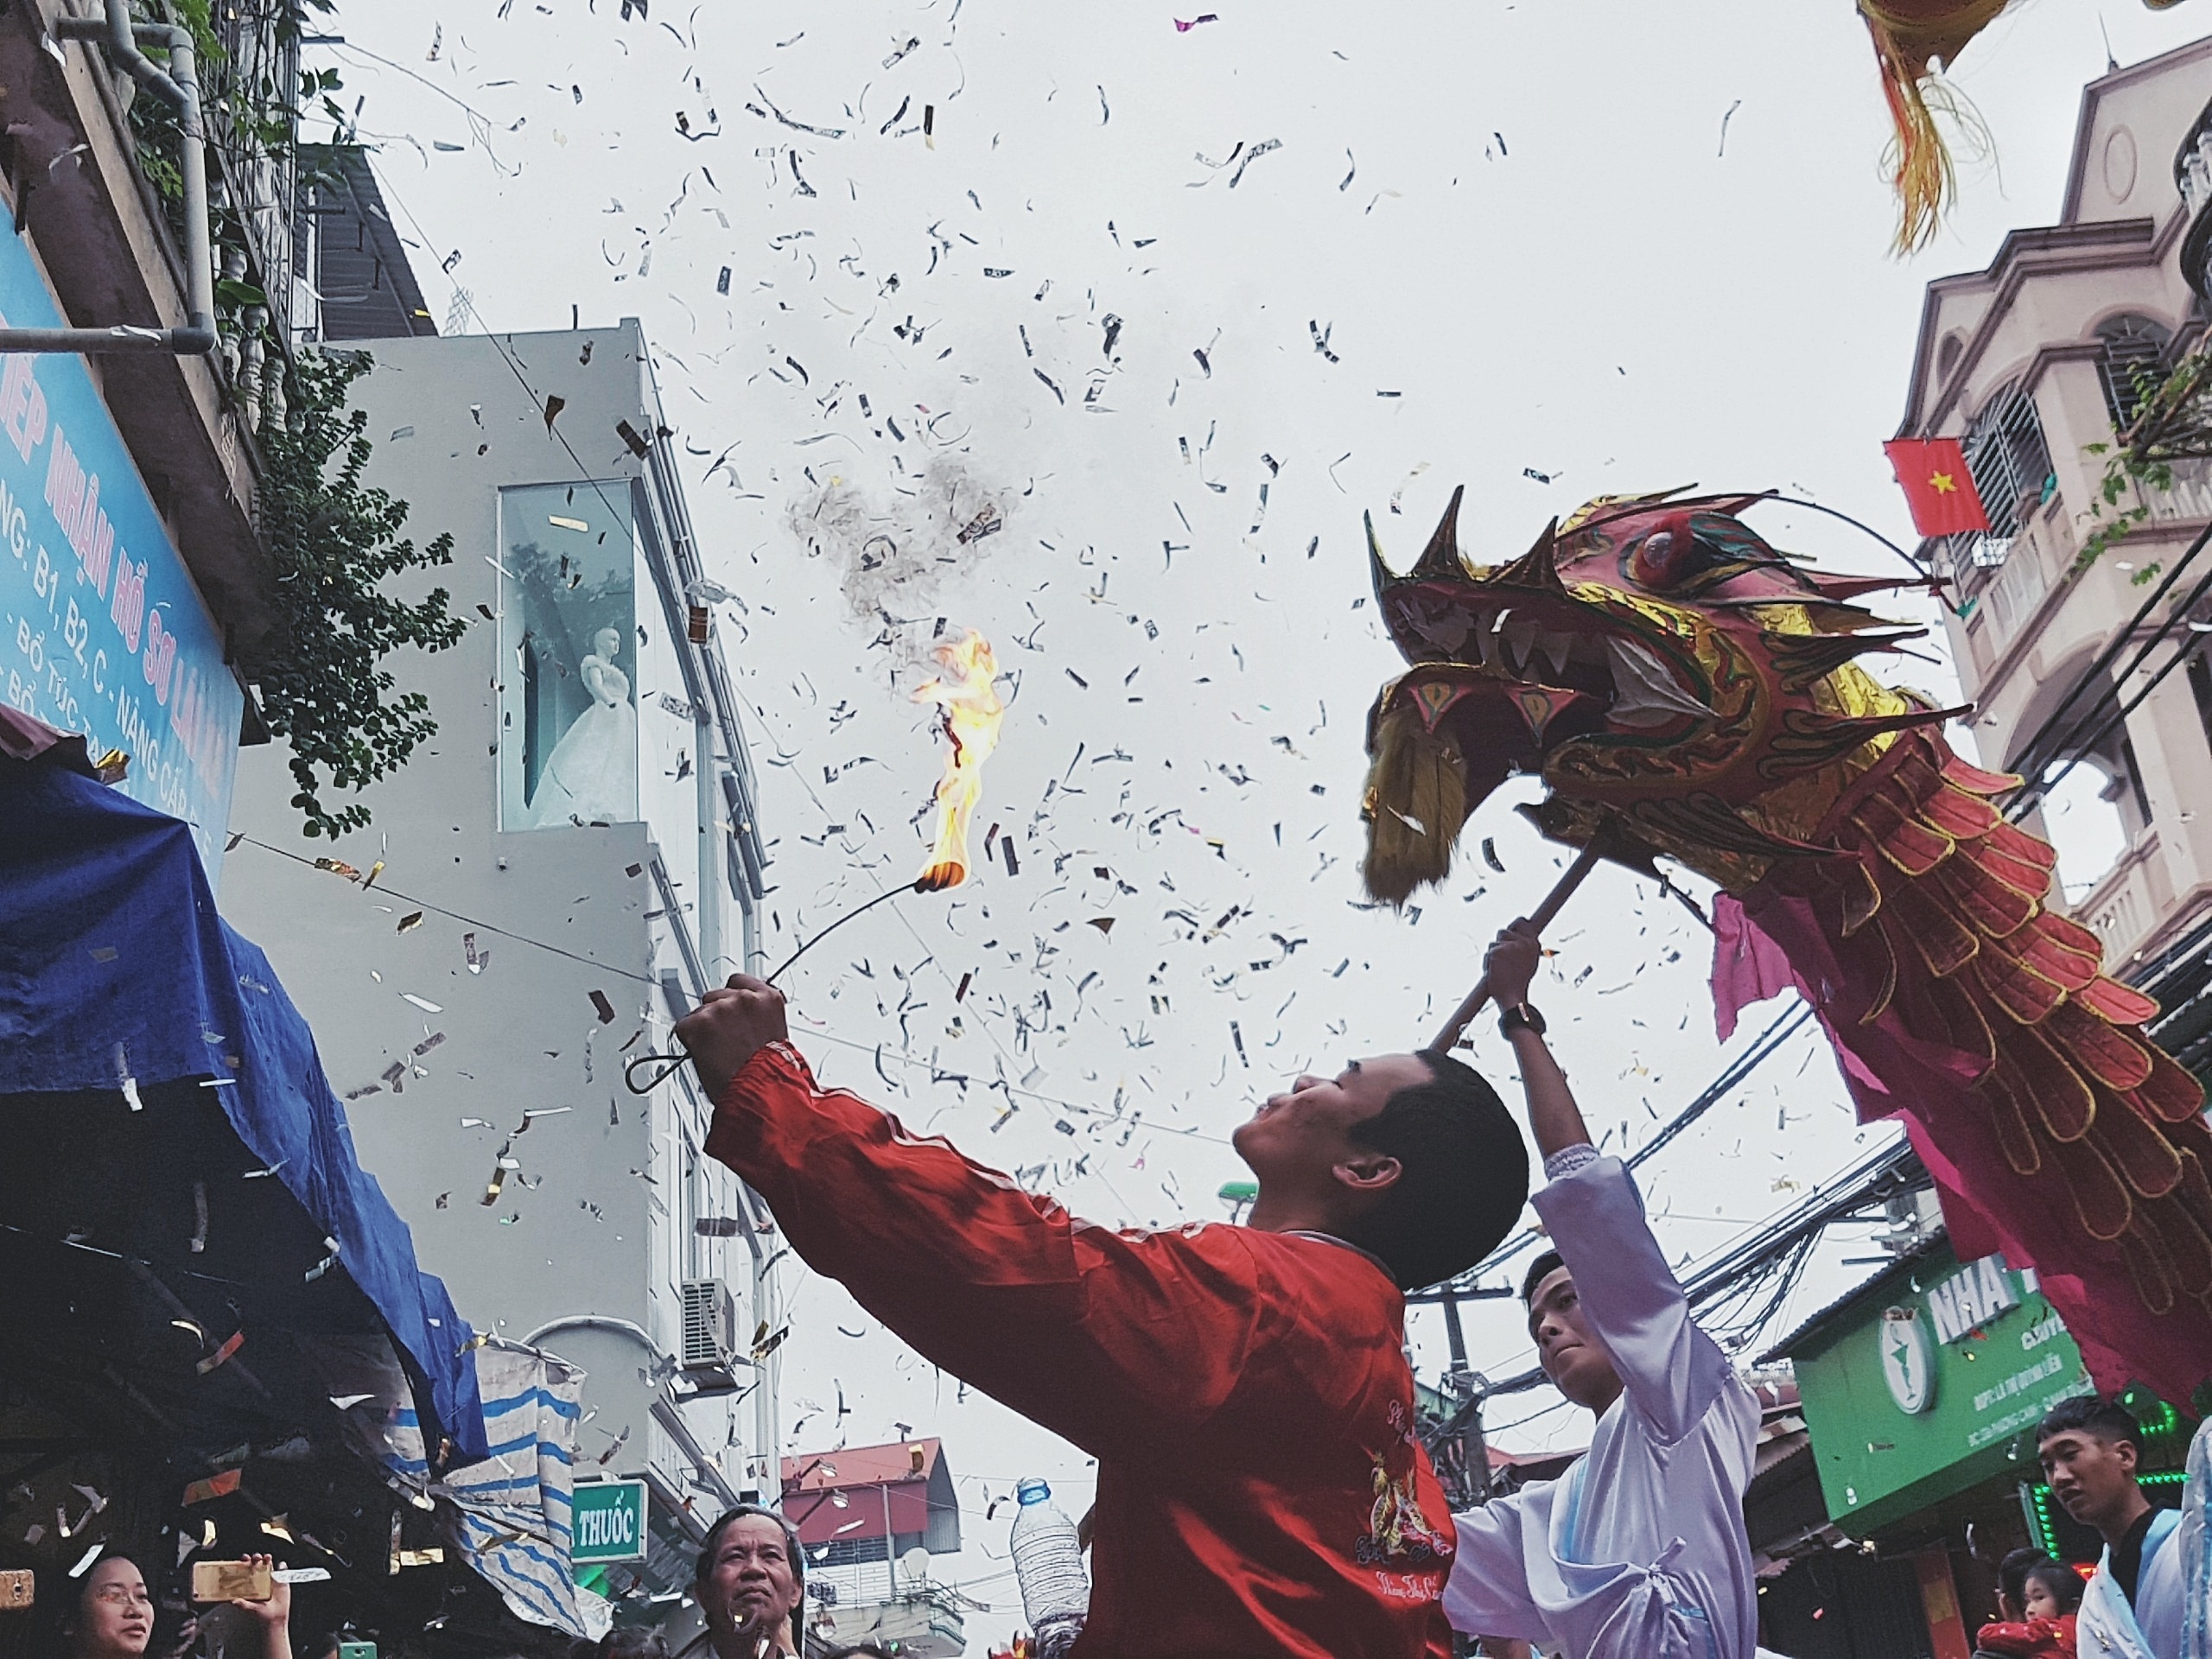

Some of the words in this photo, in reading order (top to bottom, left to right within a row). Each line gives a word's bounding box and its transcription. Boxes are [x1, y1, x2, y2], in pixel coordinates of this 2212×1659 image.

[45, 423, 114, 601] NHẬN
[143, 608, 176, 706] SƠ
[93, 649, 107, 694] C
[116, 683, 159, 781] NÂNG
[579, 1490, 633, 1547] THUỐC
